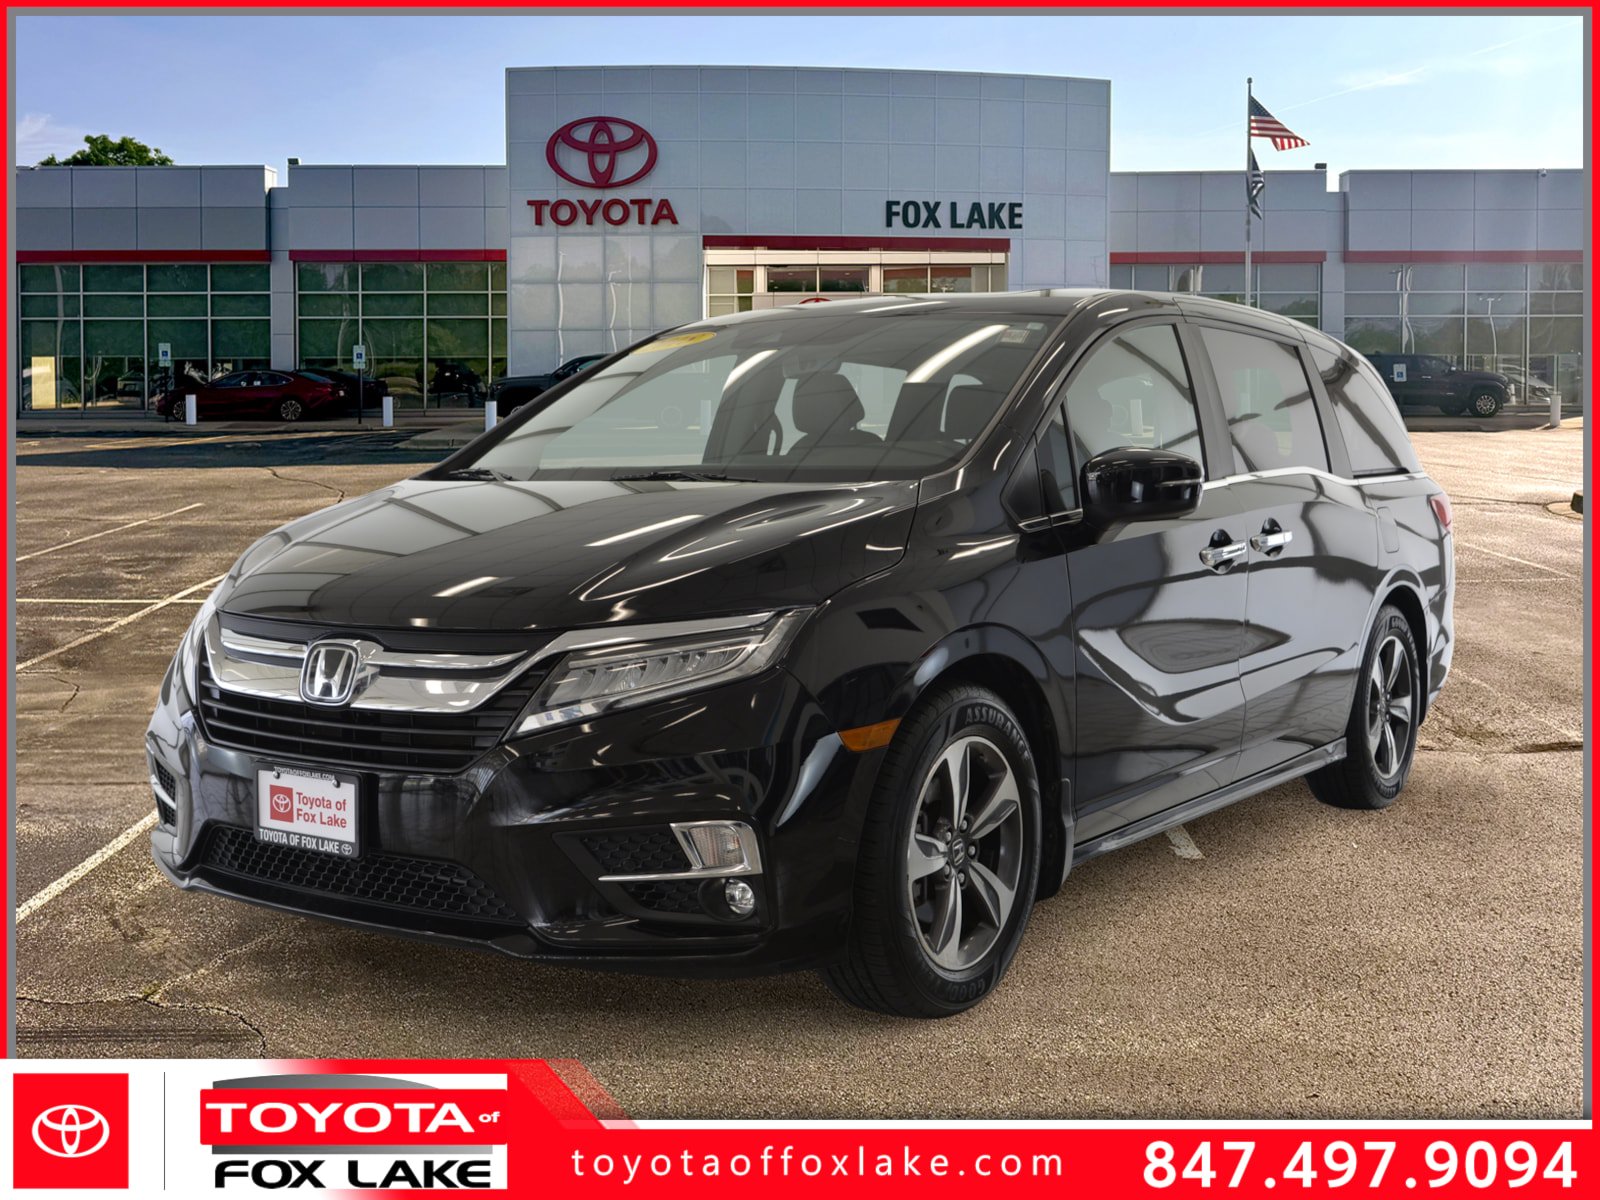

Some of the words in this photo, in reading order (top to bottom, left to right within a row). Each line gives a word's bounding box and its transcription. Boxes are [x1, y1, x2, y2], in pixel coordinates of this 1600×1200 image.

[527, 199, 679, 226] TOYOTA
[885, 200, 942, 229] FOX
[949, 201, 1023, 230] LAKE
[965, 706, 1031, 761] ASSURANCE
[296, 791, 332, 810] Toyota
[335, 799, 347, 812] of
[296, 808, 317, 824] Fox
[320, 812, 347, 829] Lake
[259, 828, 288, 845] TOYOTA
[289, 834, 300, 846] OF
[301, 835, 317, 850] FOX
[318, 839, 340, 854] LAKE
